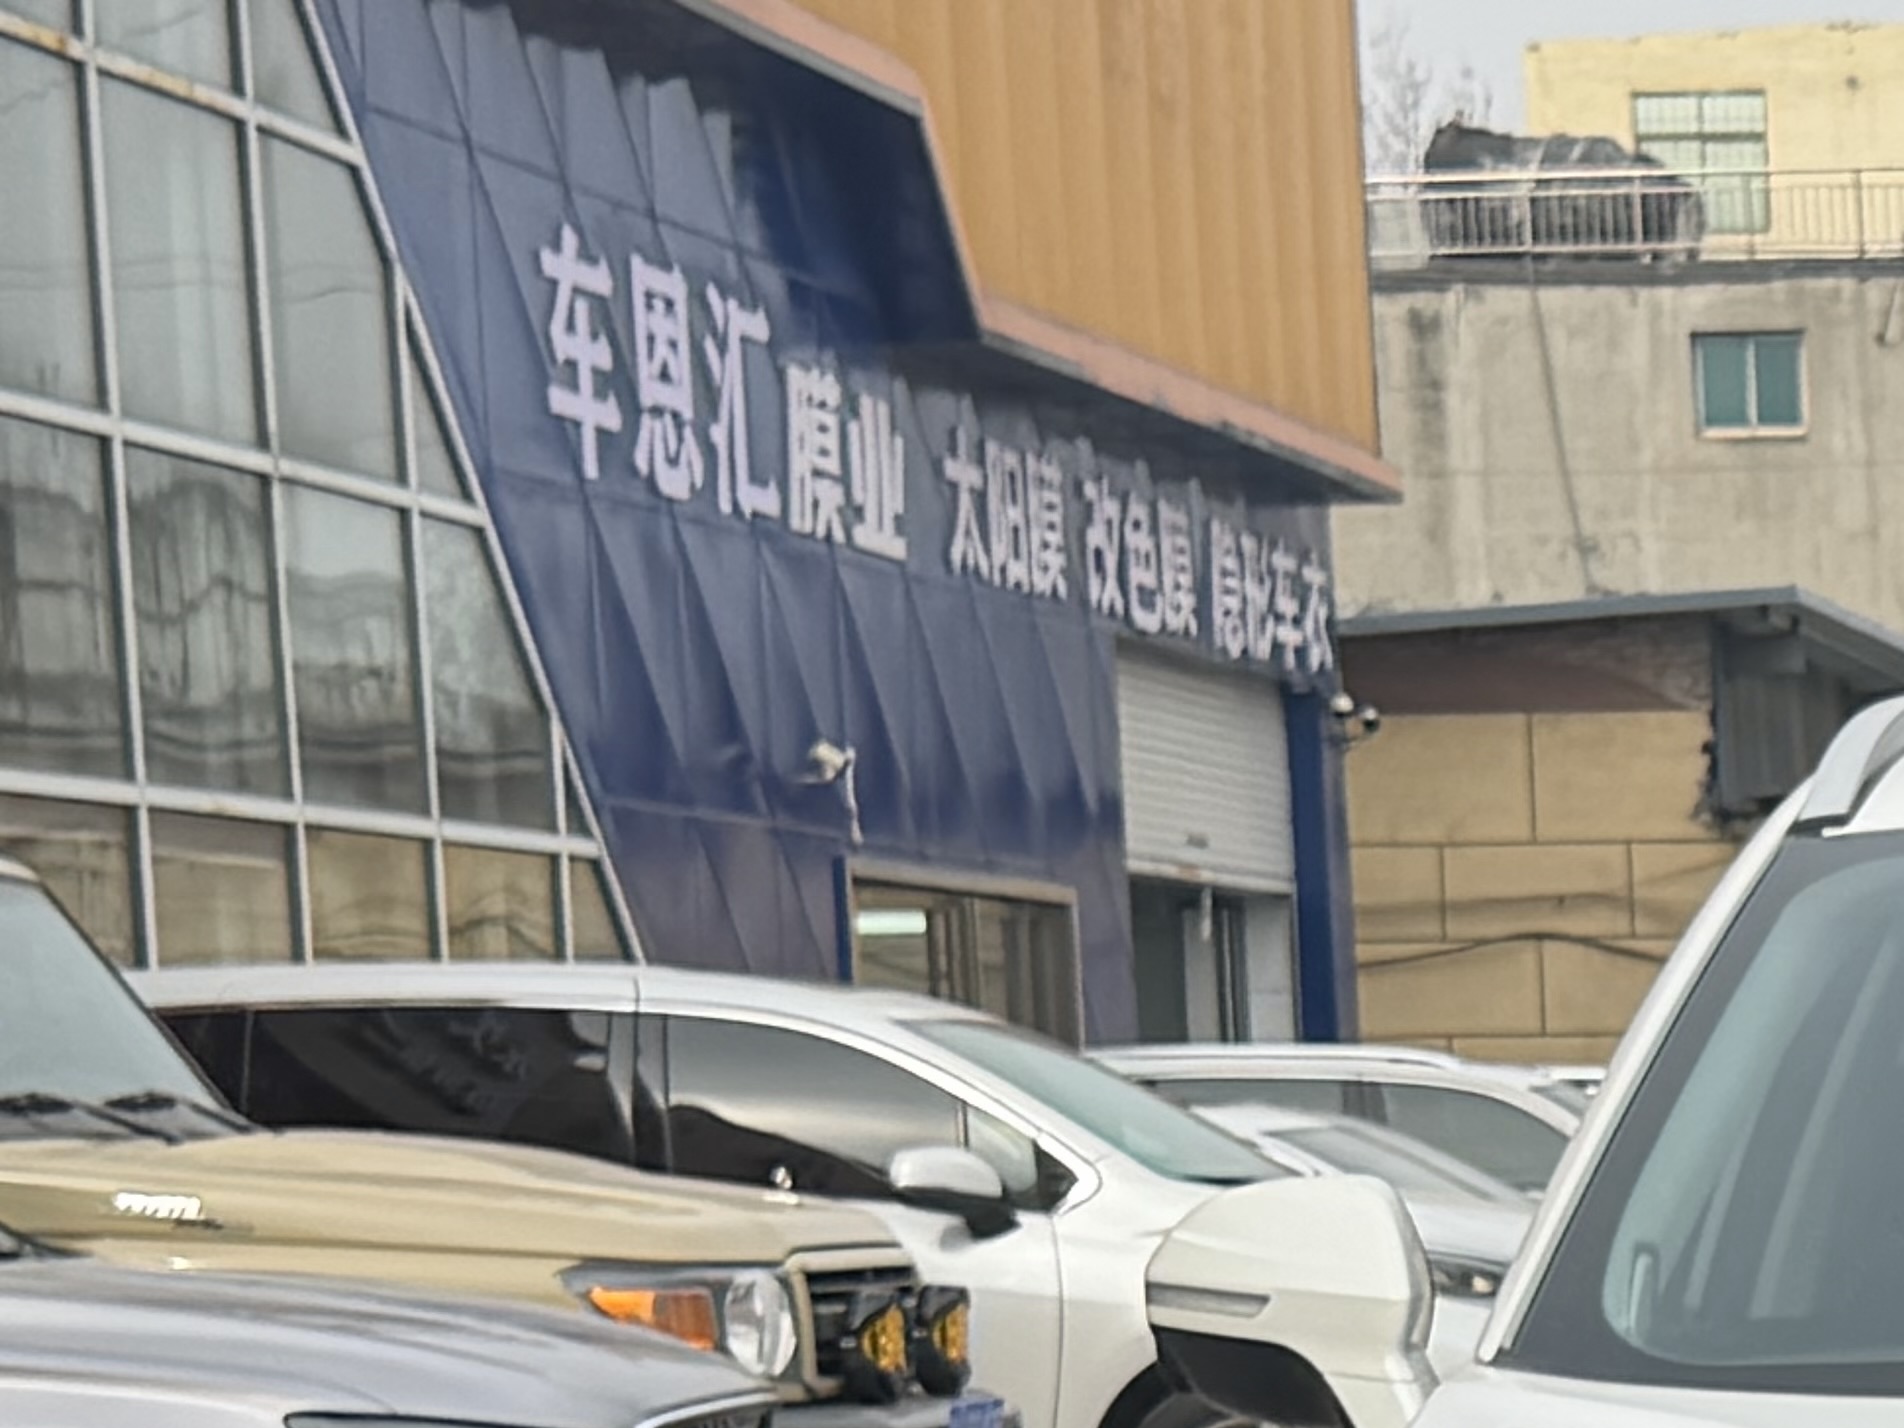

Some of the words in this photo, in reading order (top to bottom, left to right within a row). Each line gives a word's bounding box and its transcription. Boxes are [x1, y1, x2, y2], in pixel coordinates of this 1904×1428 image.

[943, 425, 1068, 599] 太阳膜
[1082, 475, 1199, 638] 改色膜
[1211, 517, 1334, 674] 隐形车衣
